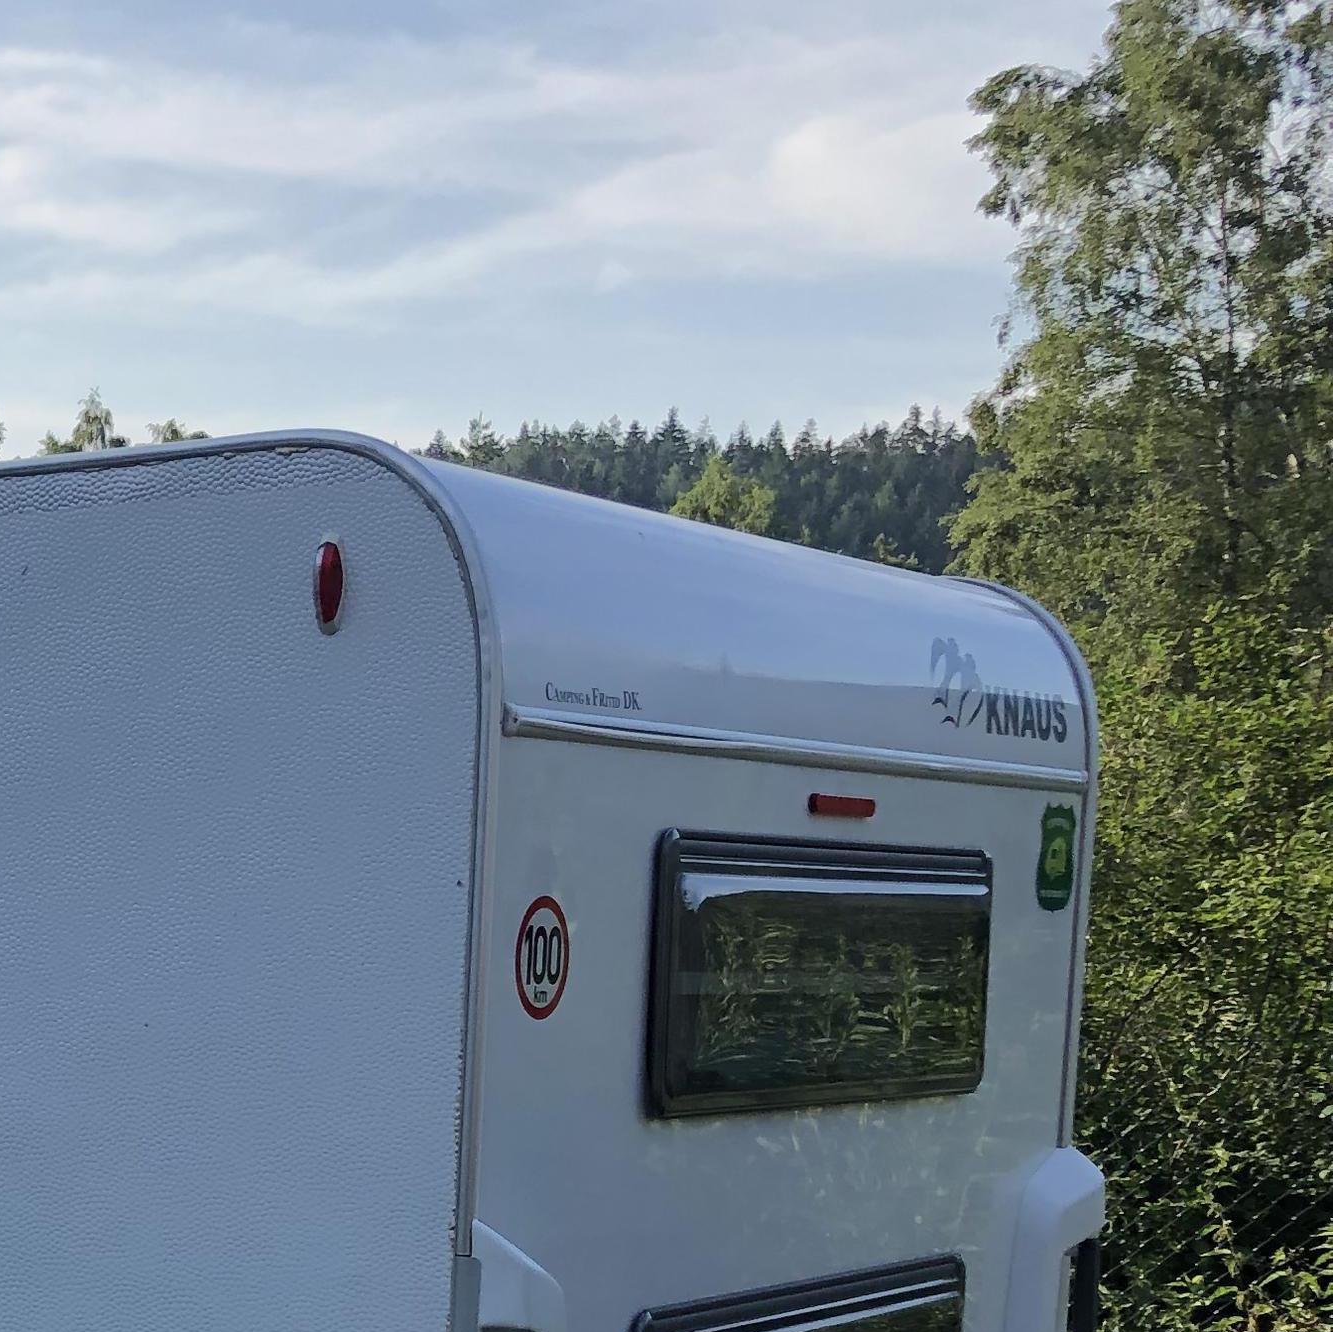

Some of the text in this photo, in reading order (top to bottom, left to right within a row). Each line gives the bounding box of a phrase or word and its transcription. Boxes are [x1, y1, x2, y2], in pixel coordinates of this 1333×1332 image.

[985, 686, 1067, 743] KNAUS
[525, 924, 562, 986] 100
[533, 985, 548, 1003] km
